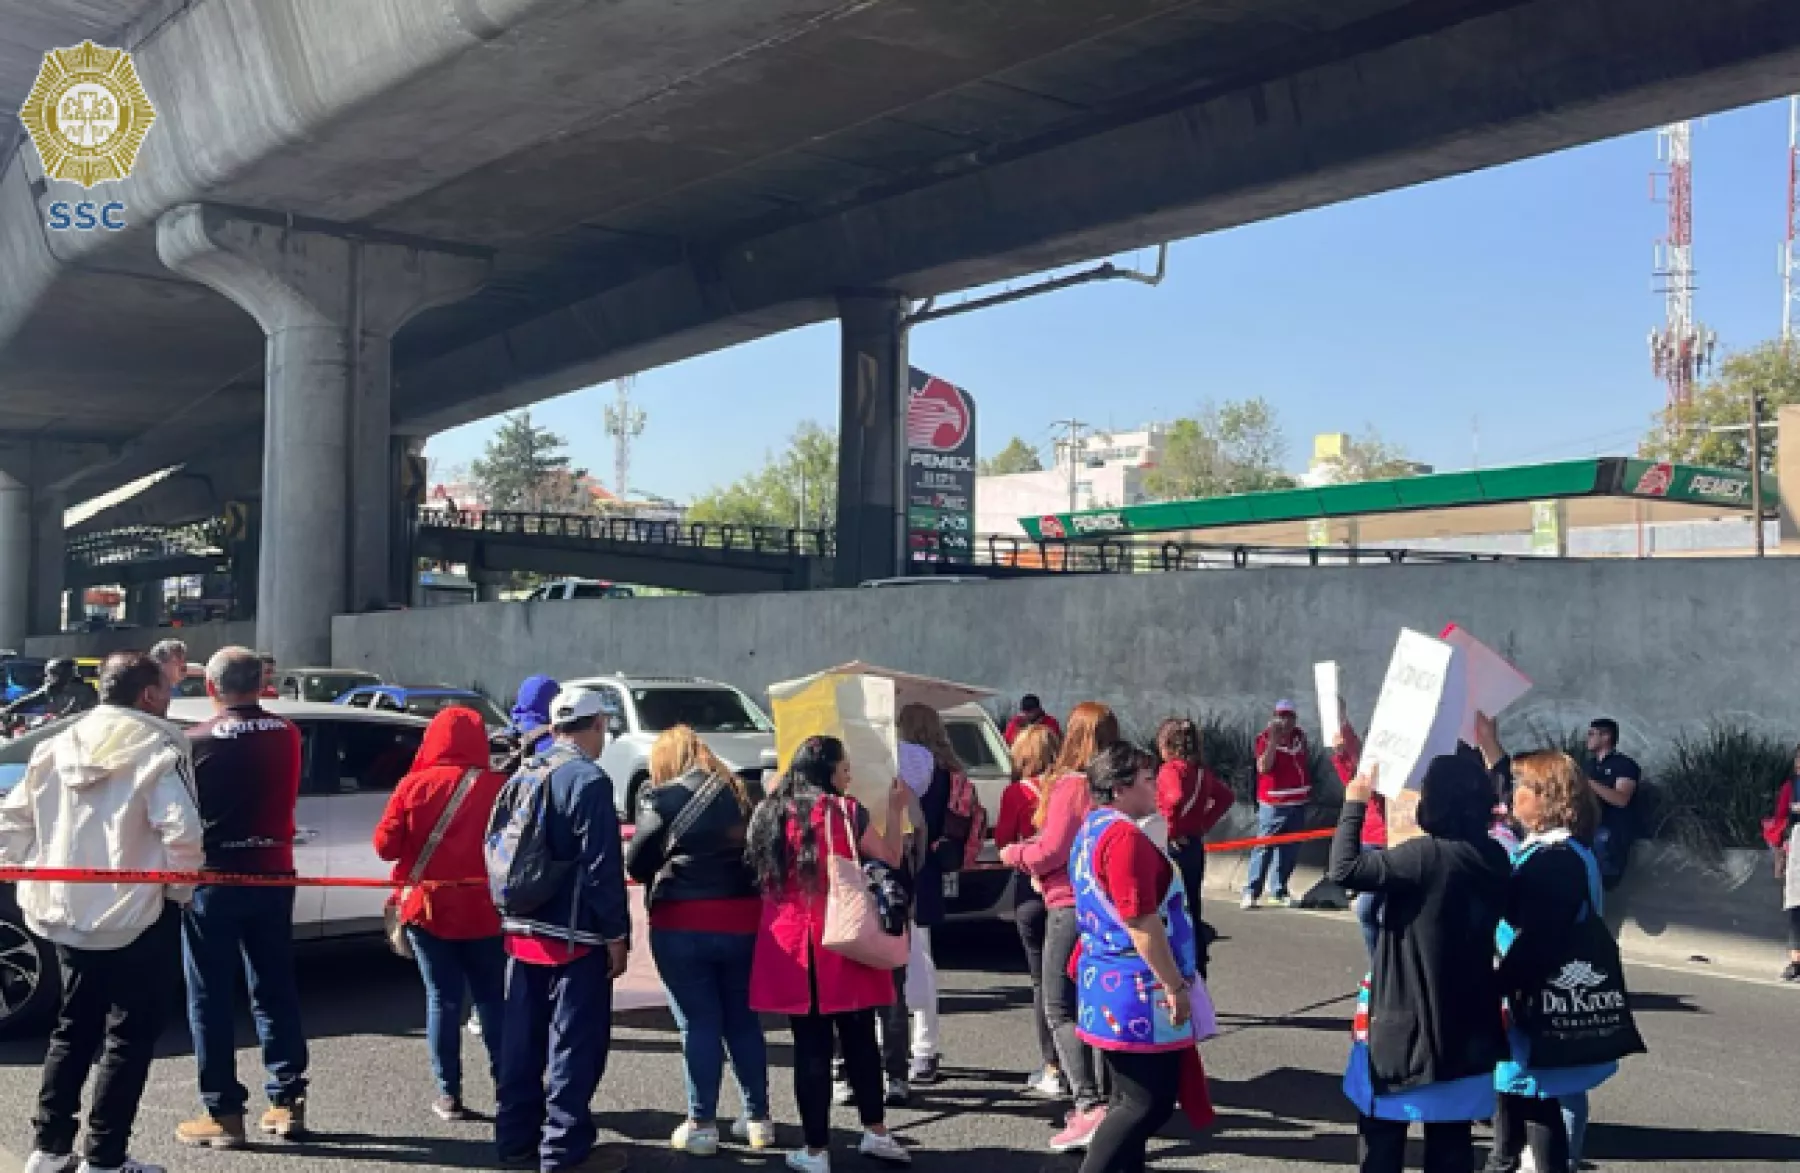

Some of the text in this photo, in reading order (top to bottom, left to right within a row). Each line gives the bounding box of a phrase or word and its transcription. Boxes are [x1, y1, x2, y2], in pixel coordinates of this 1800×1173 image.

[910, 453, 973, 471] PEMEX
[1687, 474, 1748, 497] PEMEX
[1072, 512, 1122, 534] PEMEX
